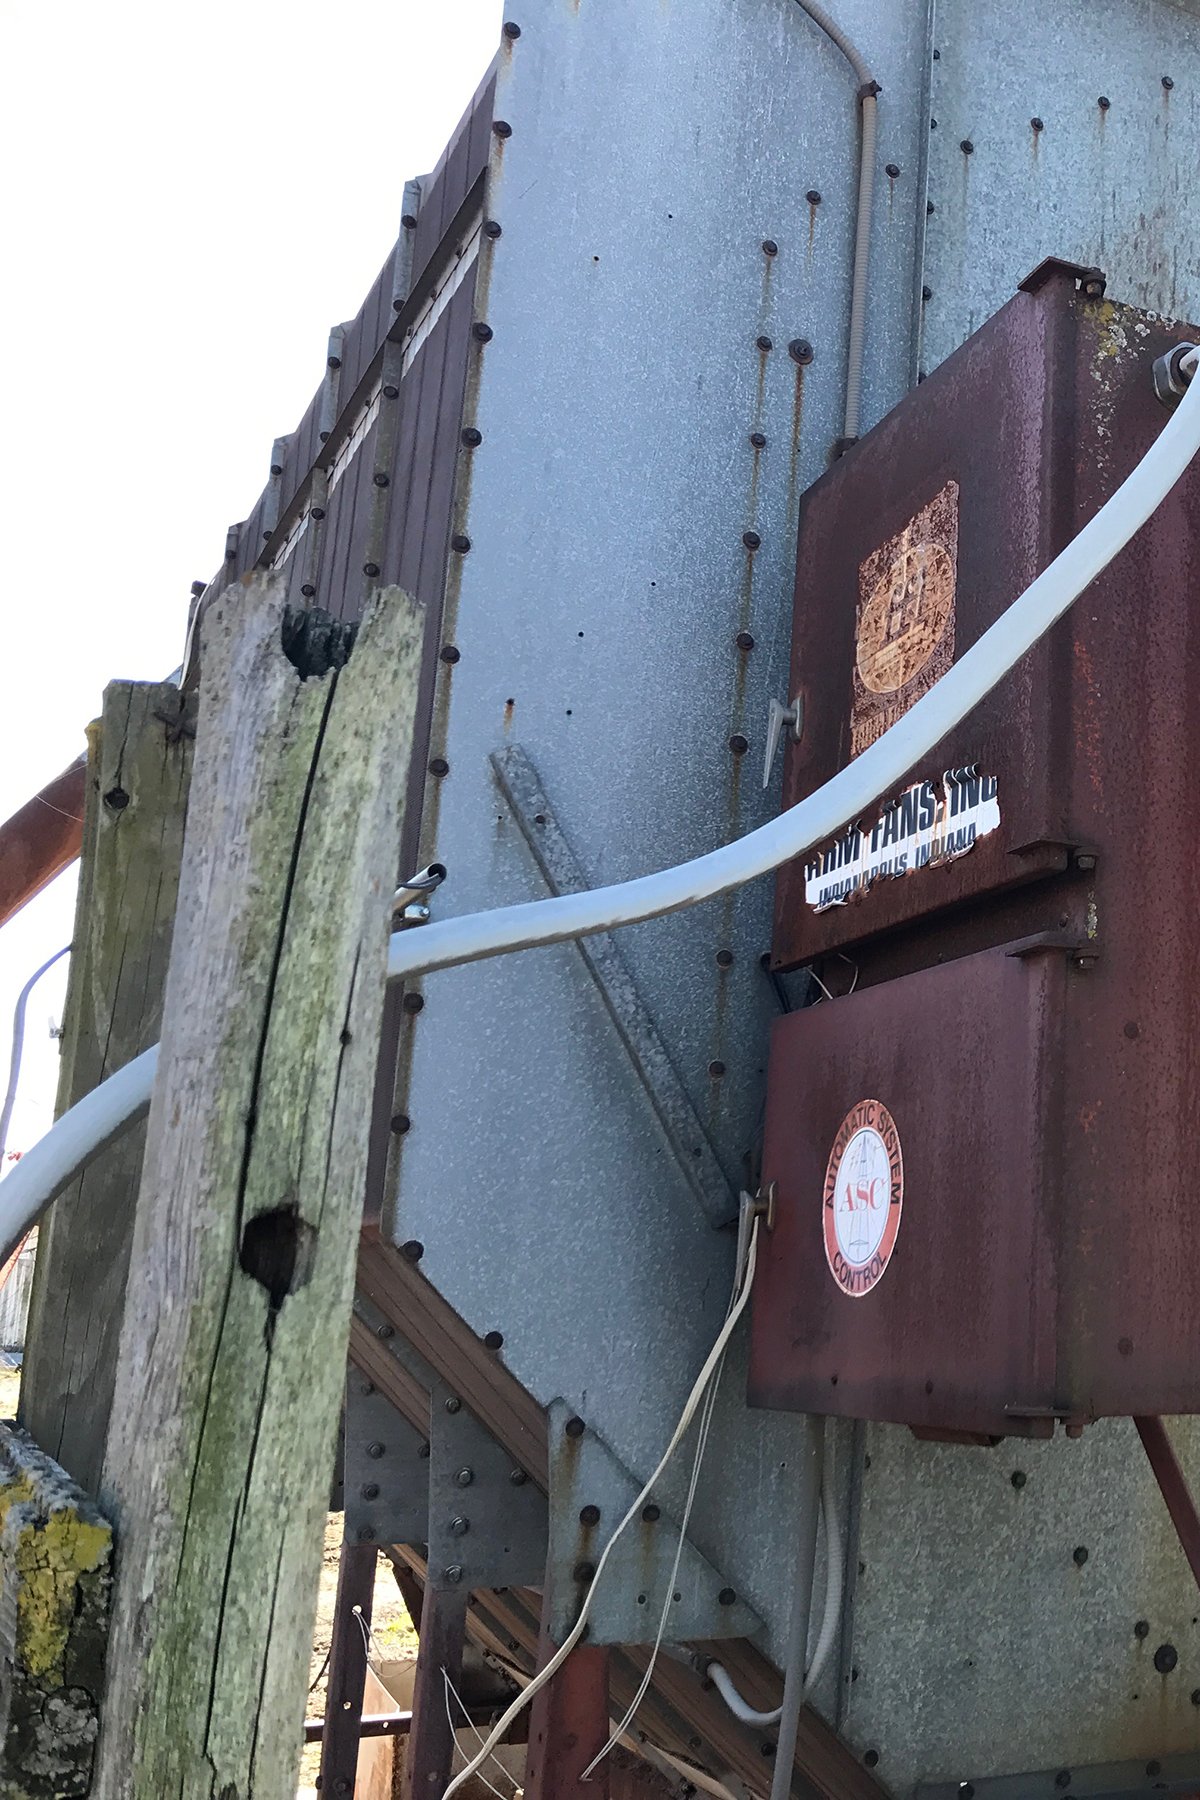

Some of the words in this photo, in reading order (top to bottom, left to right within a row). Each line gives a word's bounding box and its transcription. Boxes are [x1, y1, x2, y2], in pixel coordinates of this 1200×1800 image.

[915, 822, 976, 868] INDIANA
[825, 1104, 875, 1209] AUTOMATIC
[878, 1110, 900, 1205] SYSTEM
[839, 1177, 885, 1212] ASC
[833, 1250, 887, 1292] CONTROL
